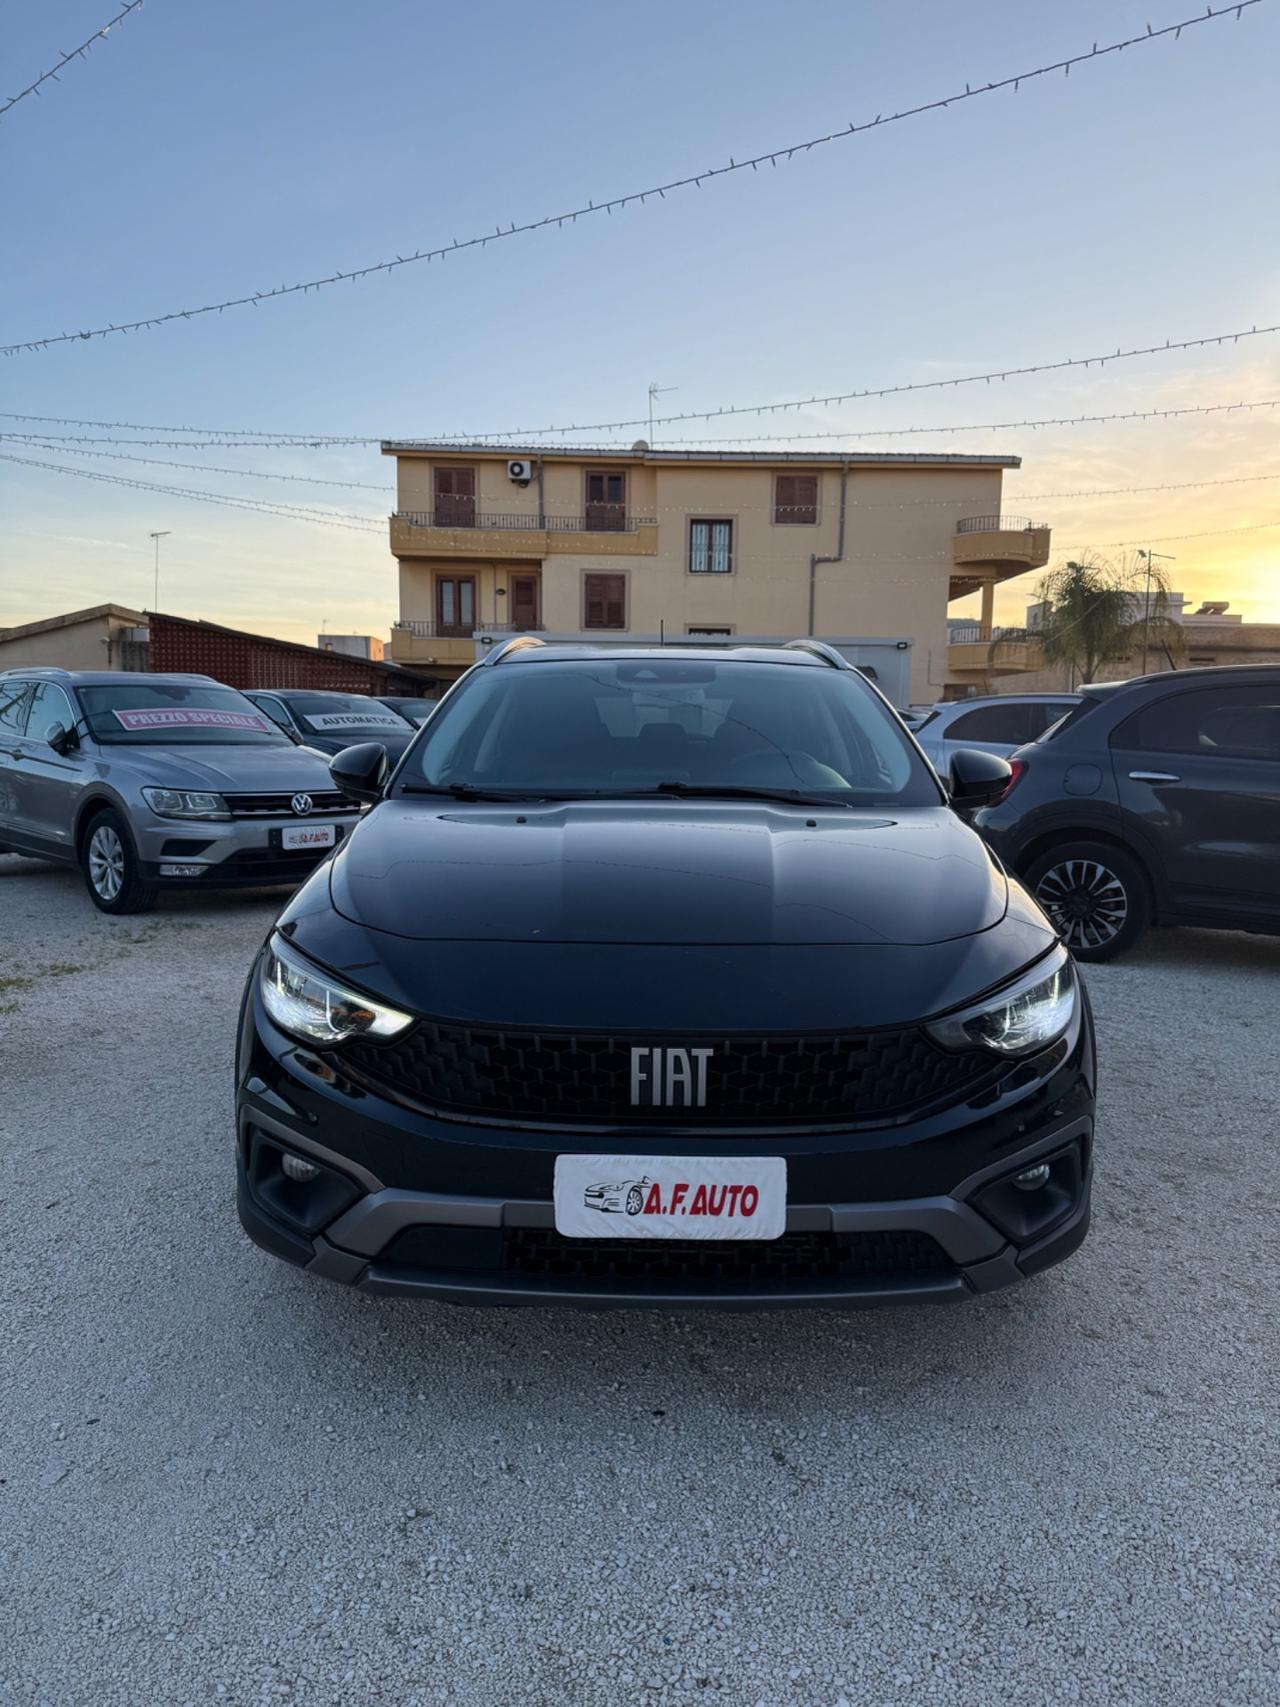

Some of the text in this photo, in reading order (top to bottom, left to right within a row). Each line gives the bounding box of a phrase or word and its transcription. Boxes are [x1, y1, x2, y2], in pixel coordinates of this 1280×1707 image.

[127, 711, 258, 728] PREZZO SPECIALE
[321, 716, 400, 726] AUTOMATICA
[631, 1047, 714, 1107] FIAT
